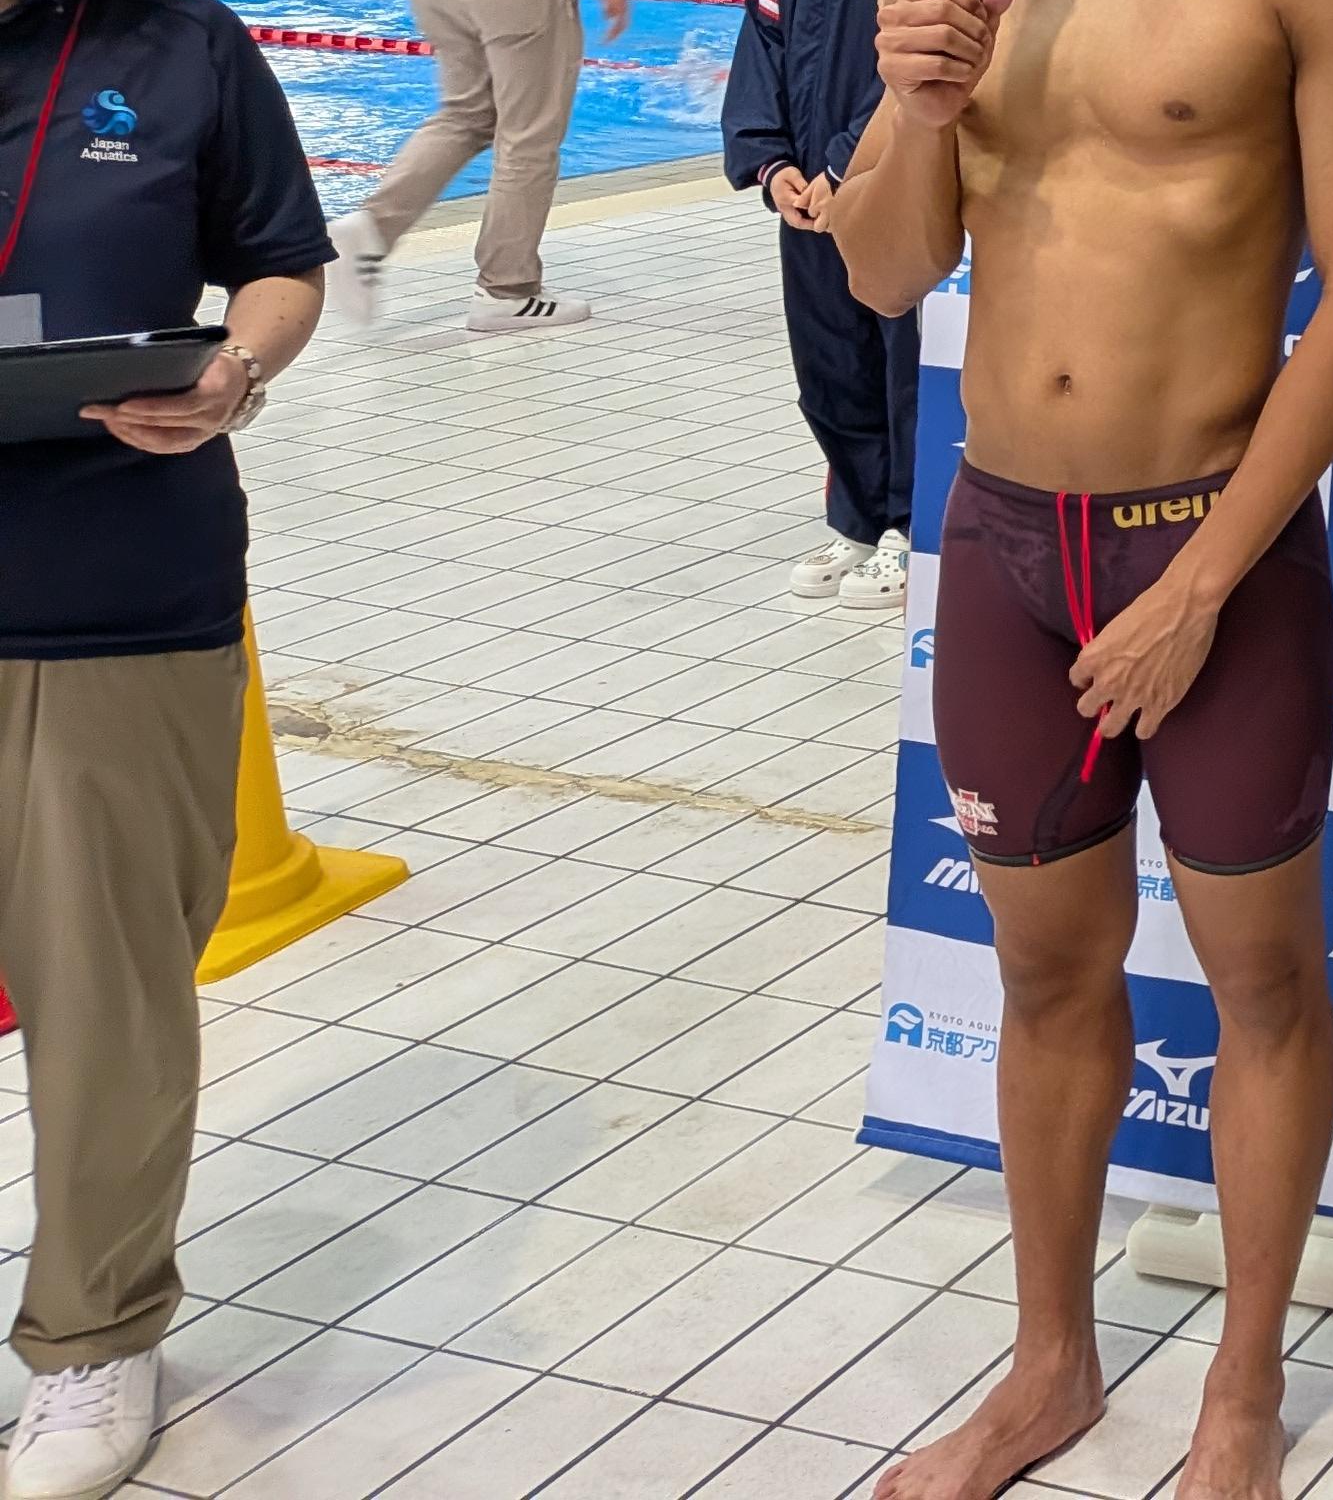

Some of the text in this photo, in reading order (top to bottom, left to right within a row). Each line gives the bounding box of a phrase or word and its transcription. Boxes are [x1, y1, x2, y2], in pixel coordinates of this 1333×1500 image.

[91, 138, 129, 151] Japan
[80, 148, 138, 162] Aquatics
[1113, 491, 1219, 529] aren
[1139, 858, 1166, 868] KYO
[929, 1011, 998, 1033] KYOTO AQUA
[925, 1026, 998, 1063] 京都アク
